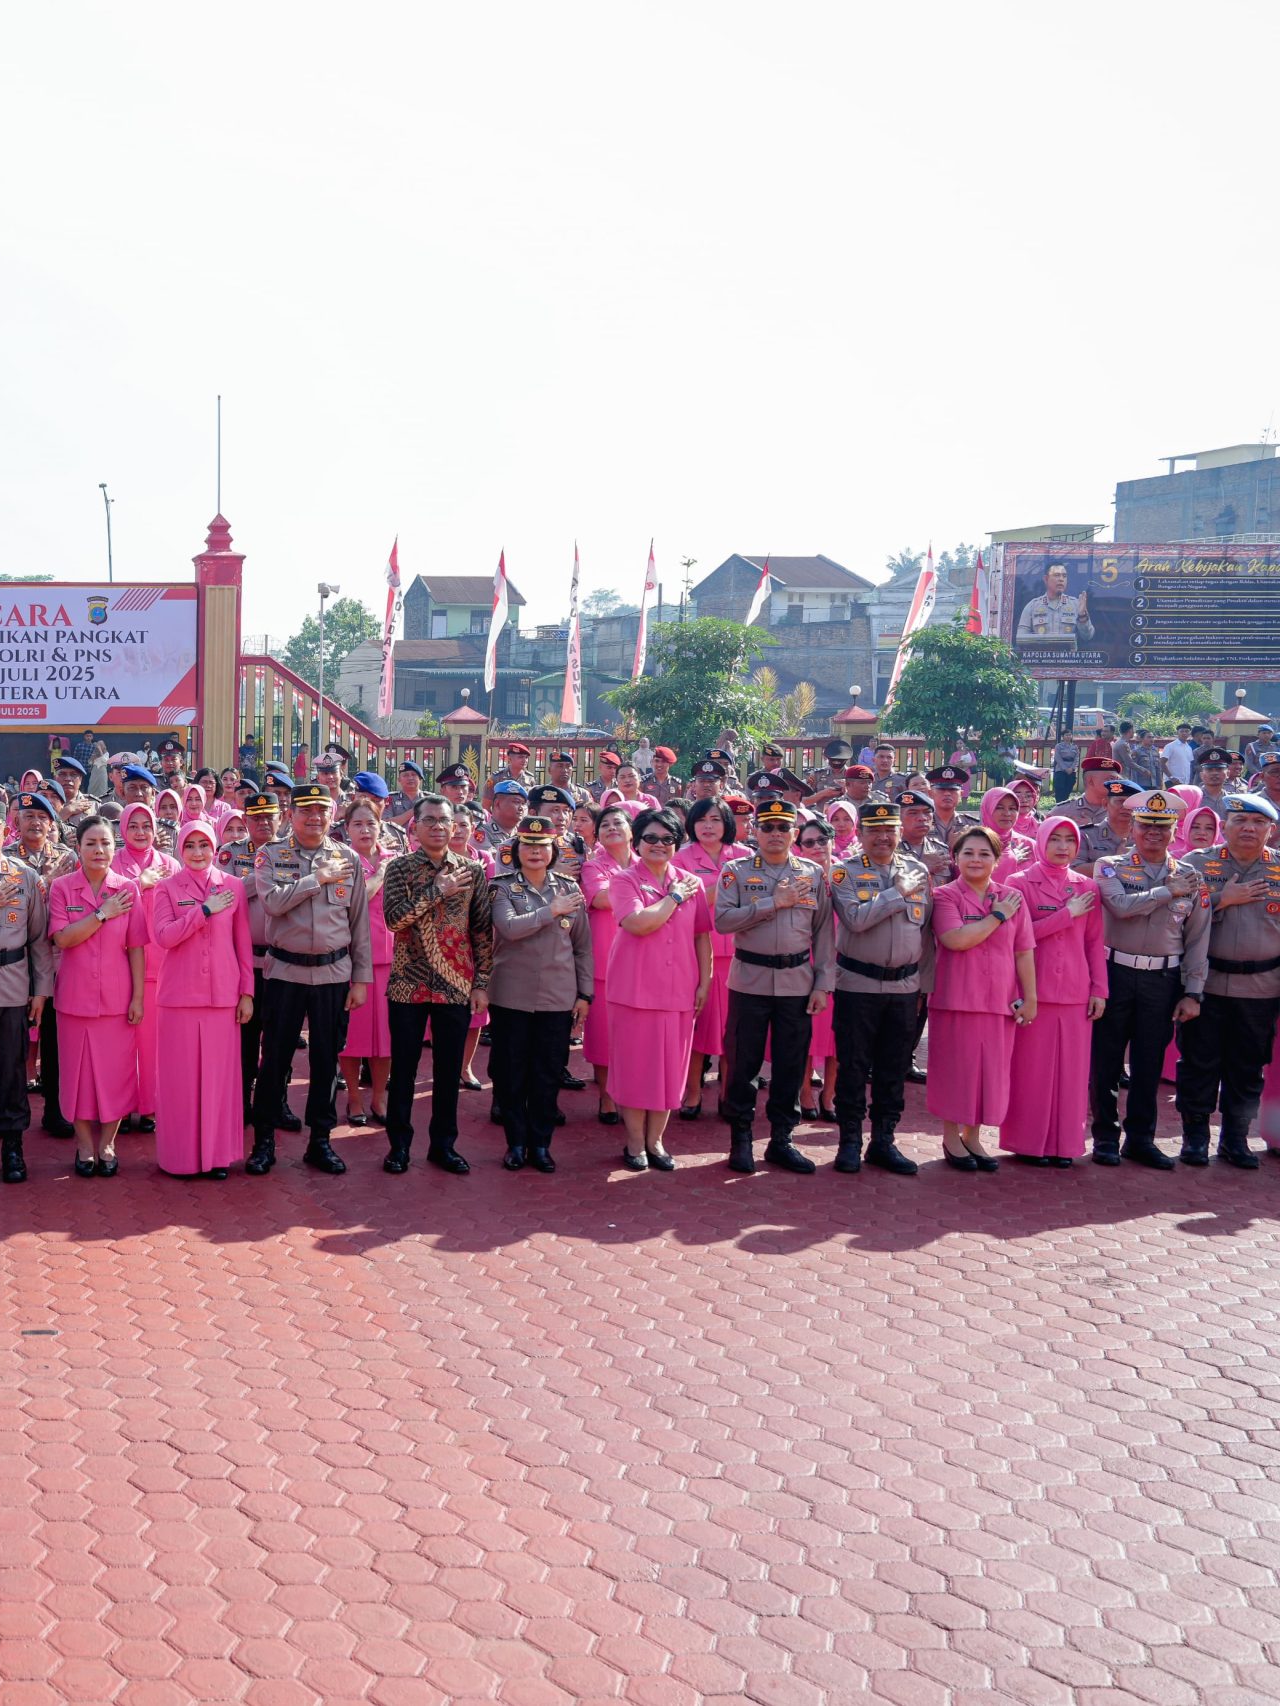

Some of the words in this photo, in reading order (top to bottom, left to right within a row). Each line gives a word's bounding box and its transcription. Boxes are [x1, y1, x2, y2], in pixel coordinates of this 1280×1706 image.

[1100, 557, 1119, 582] 5
[1135, 557, 1171, 573] Arah
[1175, 558, 1243, 576] Kebijakan
[1138, 579, 1144, 588] 1
[1136, 598, 1144, 608] 2
[1136, 616, 1143, 626] 3
[55, 630, 149, 644] PANGKAT
[1134, 635, 1142, 644] 4
[51, 646, 68, 663] &
[74, 648, 112, 663] PNS
[1134, 653, 1141, 663] 5
[0, 667, 39, 685] JULI
[45, 665, 95, 682] 2025
[55, 686, 121, 700] UTARA
[18, 707, 40, 716] 2025
